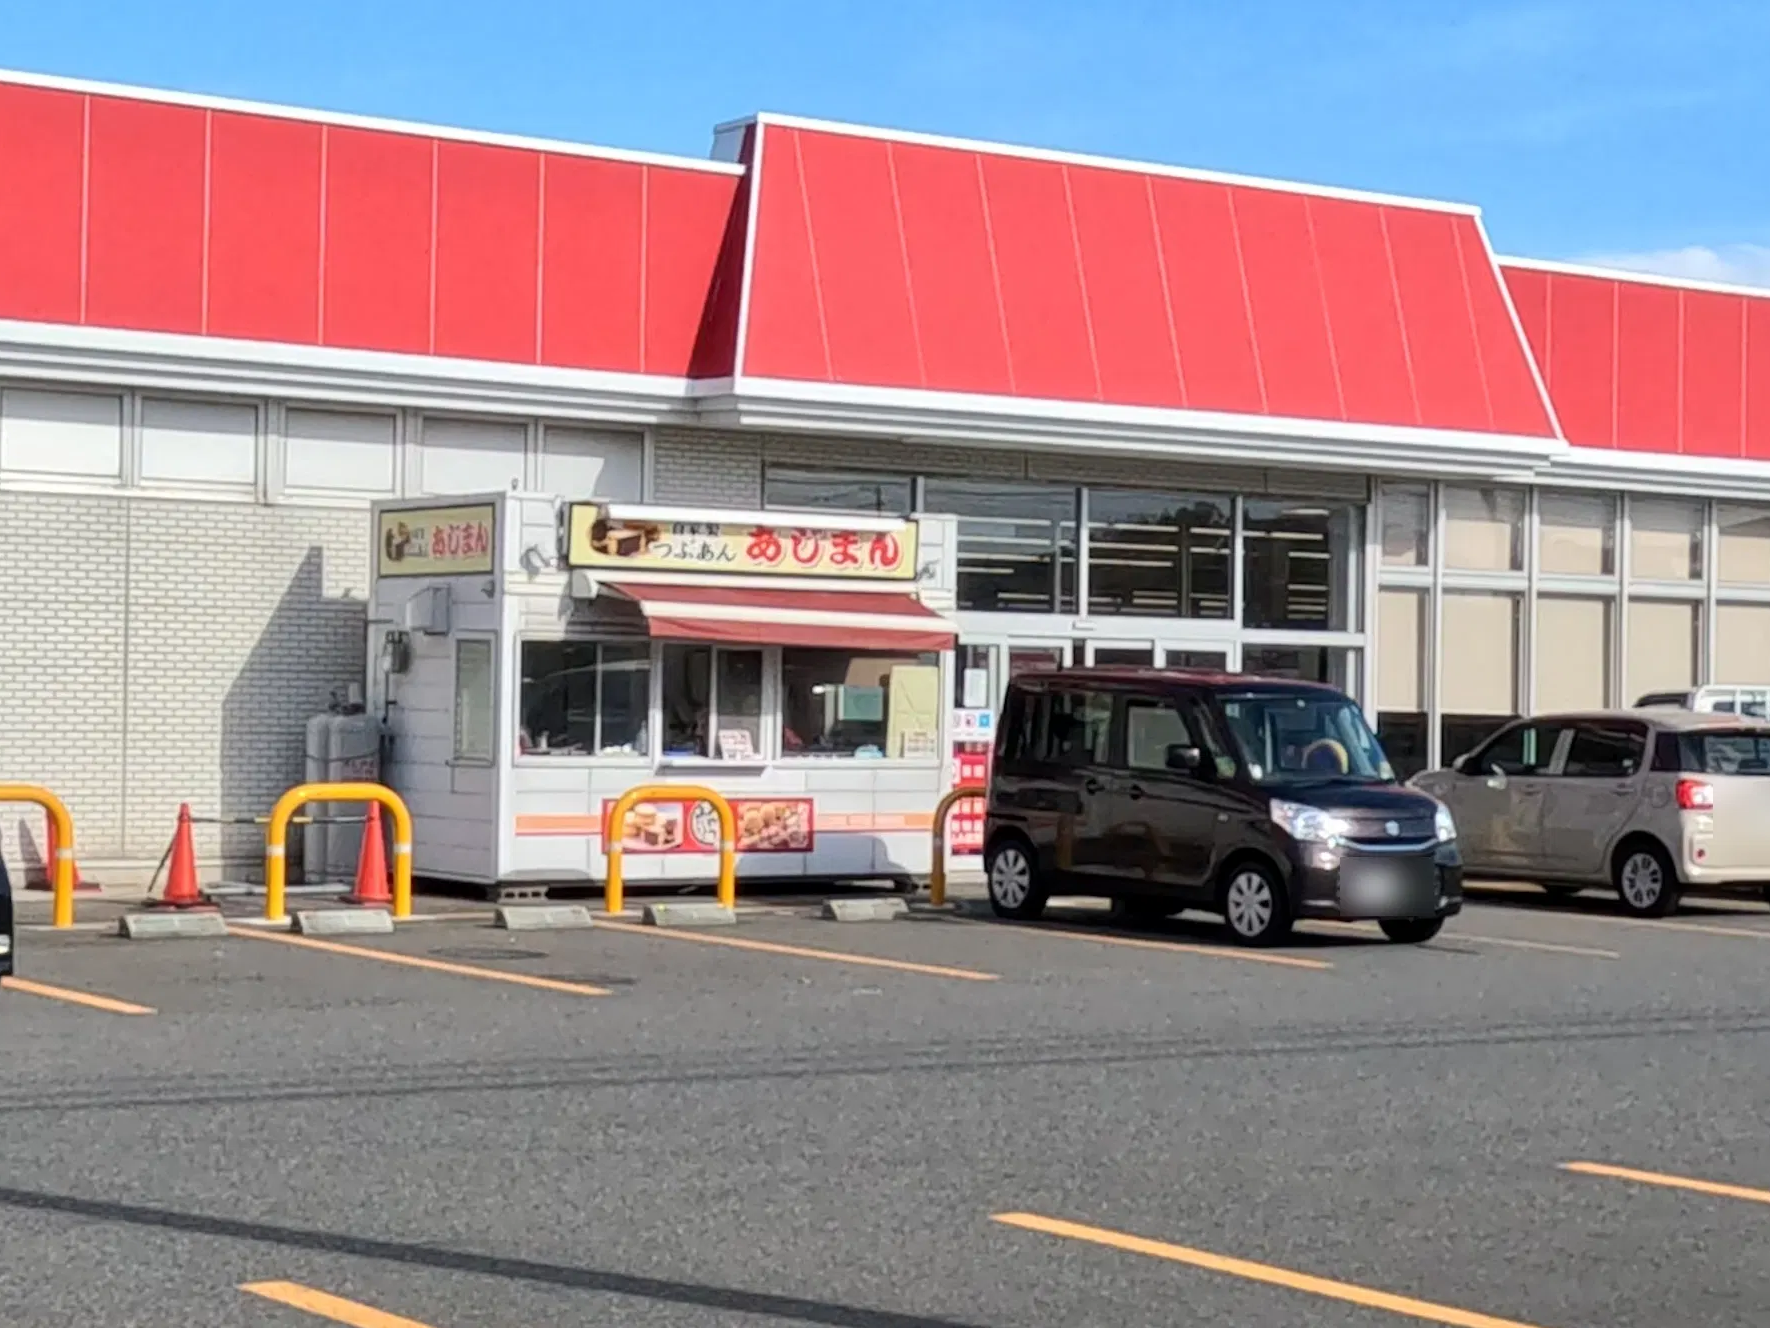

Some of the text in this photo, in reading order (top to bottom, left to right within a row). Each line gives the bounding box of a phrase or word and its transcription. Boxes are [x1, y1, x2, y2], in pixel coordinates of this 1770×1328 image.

[431, 520, 489, 557] あじまん
[653, 539, 738, 562] つぶあん
[746, 524, 899, 566] あじまん
